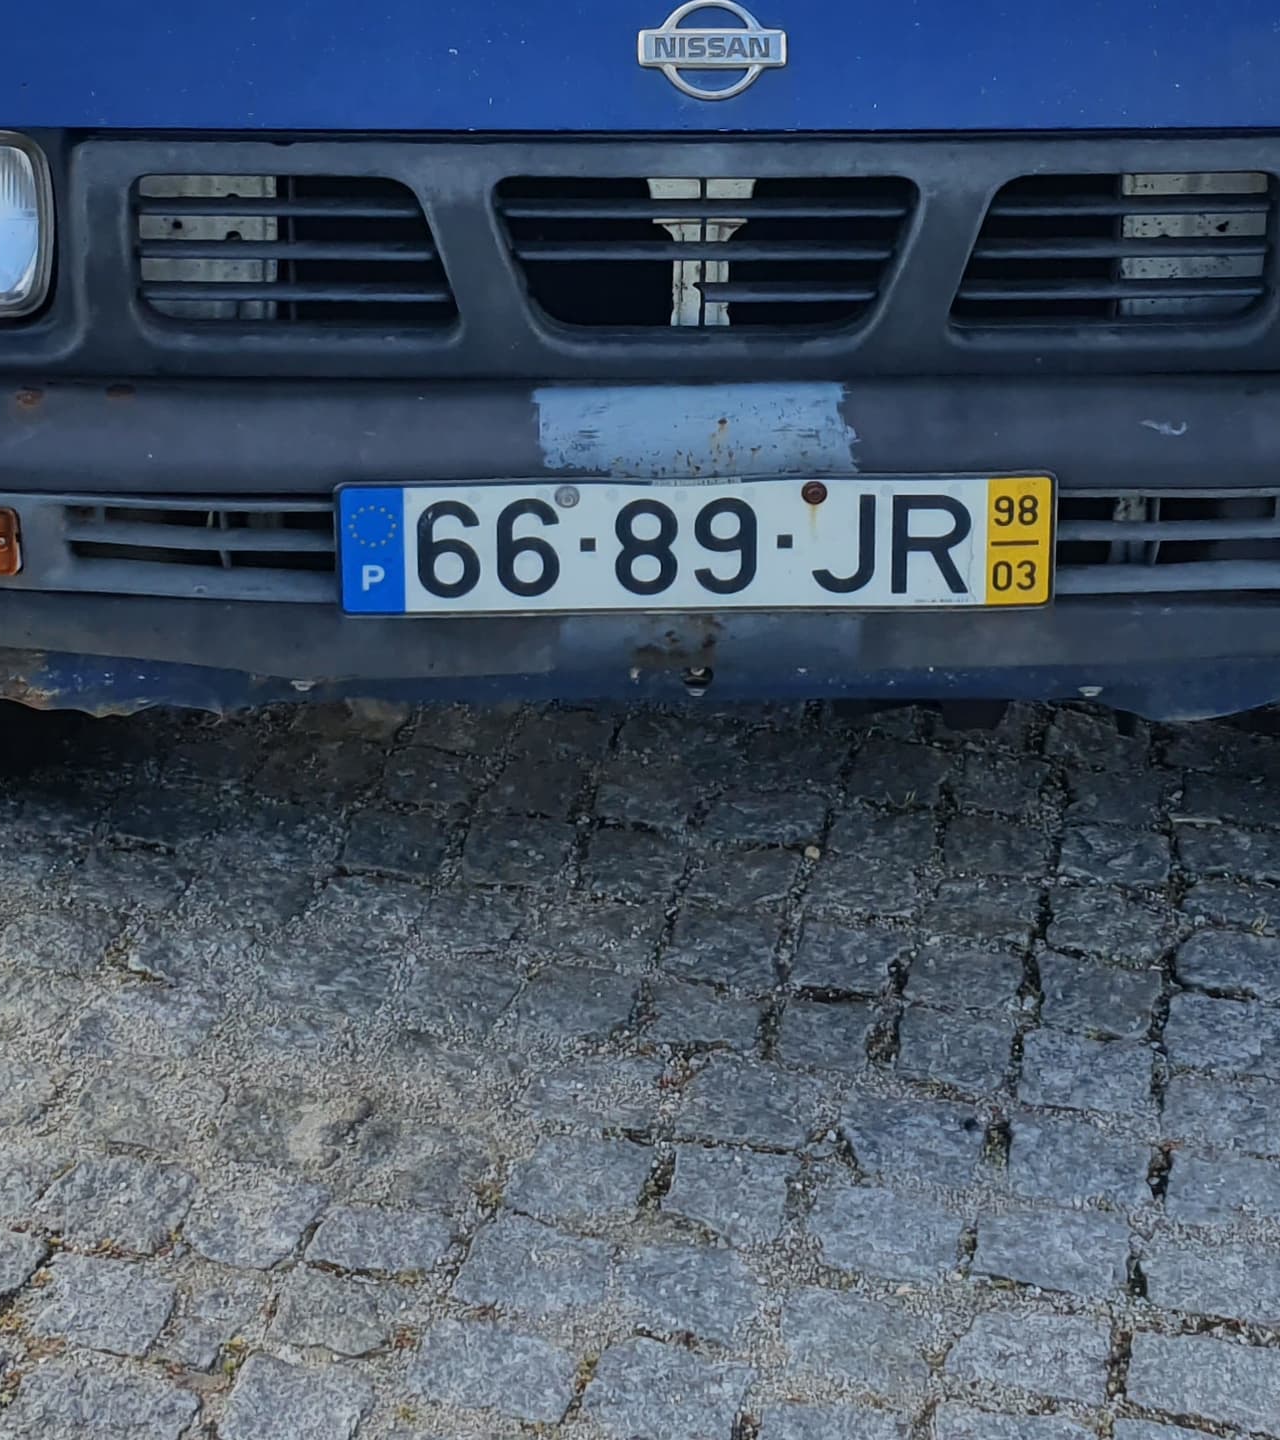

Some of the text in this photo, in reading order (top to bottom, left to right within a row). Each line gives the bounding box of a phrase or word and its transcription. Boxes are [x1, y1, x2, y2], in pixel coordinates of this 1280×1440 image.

[654, 36, 770, 59] NISSAN
[993, 494, 1039, 527] 98
[361, 564, 385, 592] P
[992, 560, 1038, 592] 03
